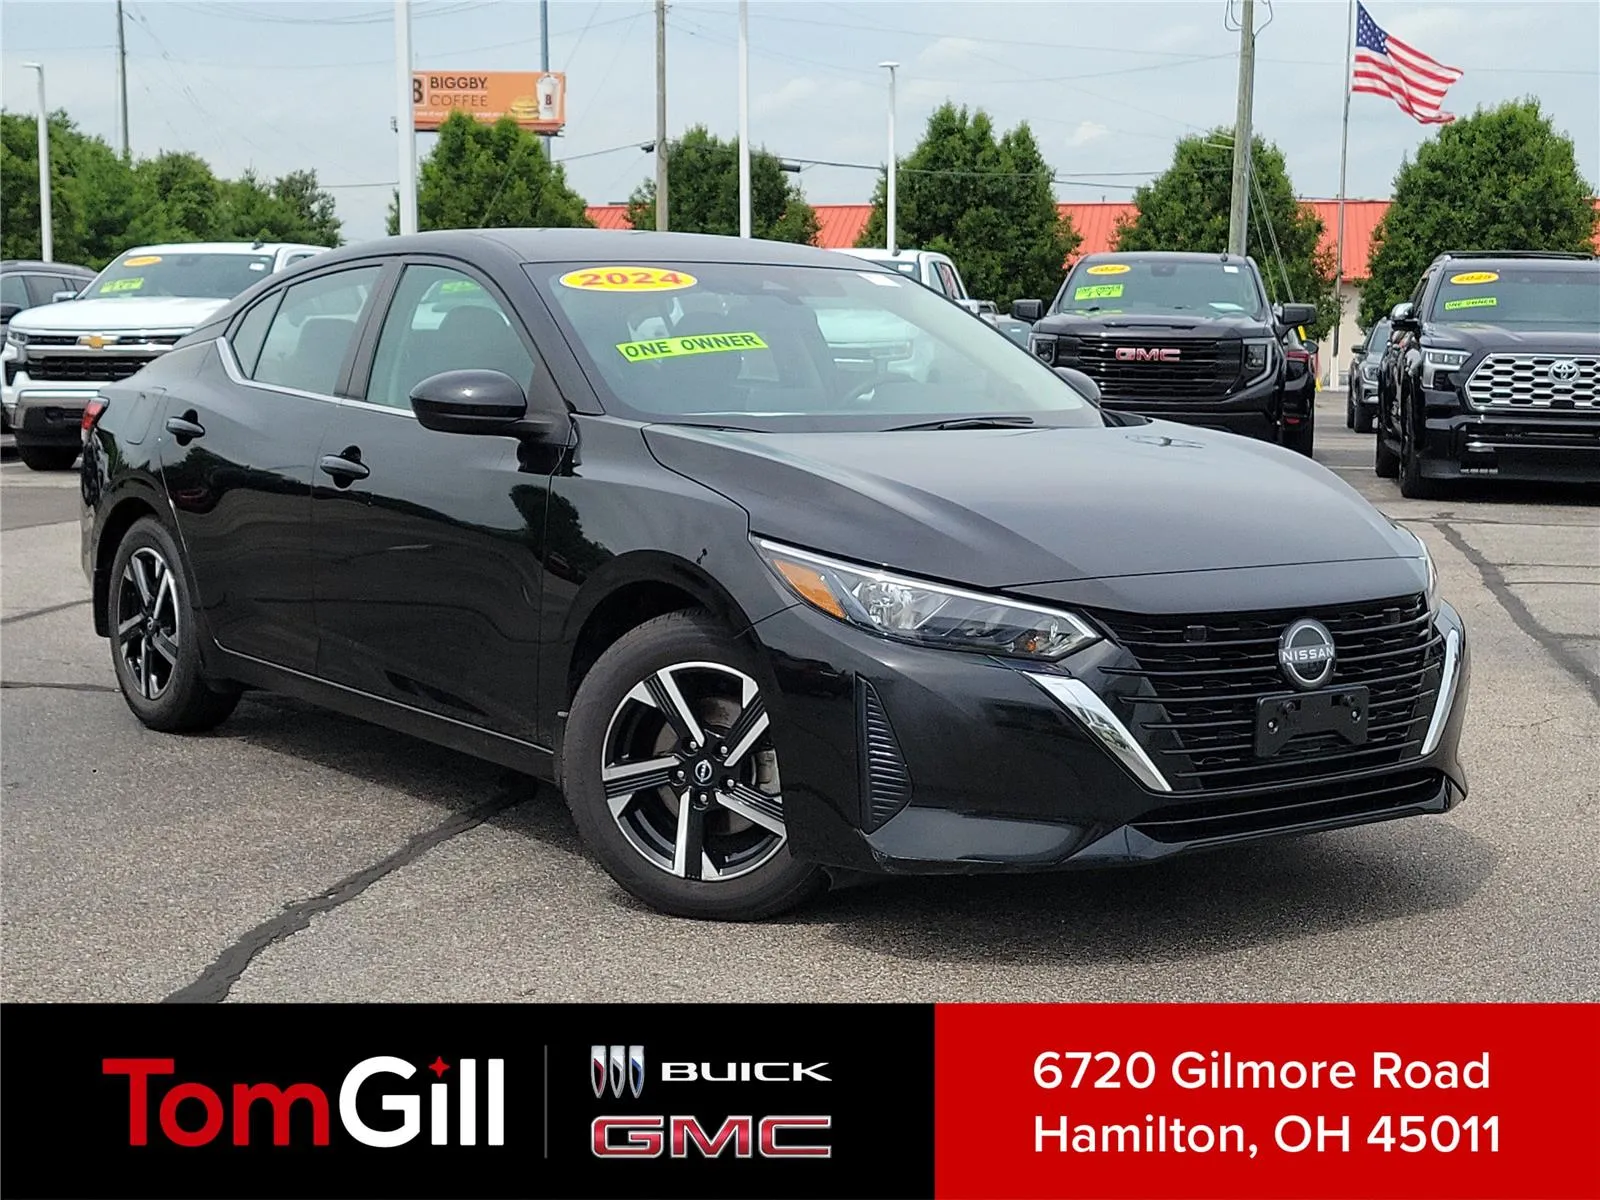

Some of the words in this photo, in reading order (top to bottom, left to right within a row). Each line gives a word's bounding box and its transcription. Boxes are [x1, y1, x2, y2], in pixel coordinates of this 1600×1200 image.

[430, 76, 488, 89] BIGGBY
[430, 94, 488, 107] COFFEE
[578, 272, 683, 286] 2024
[625, 341, 672, 358] ONE
[682, 334, 760, 352] OWNER
[1115, 347, 1181, 362] GMC
[1282, 646, 1334, 662] NISSAN
